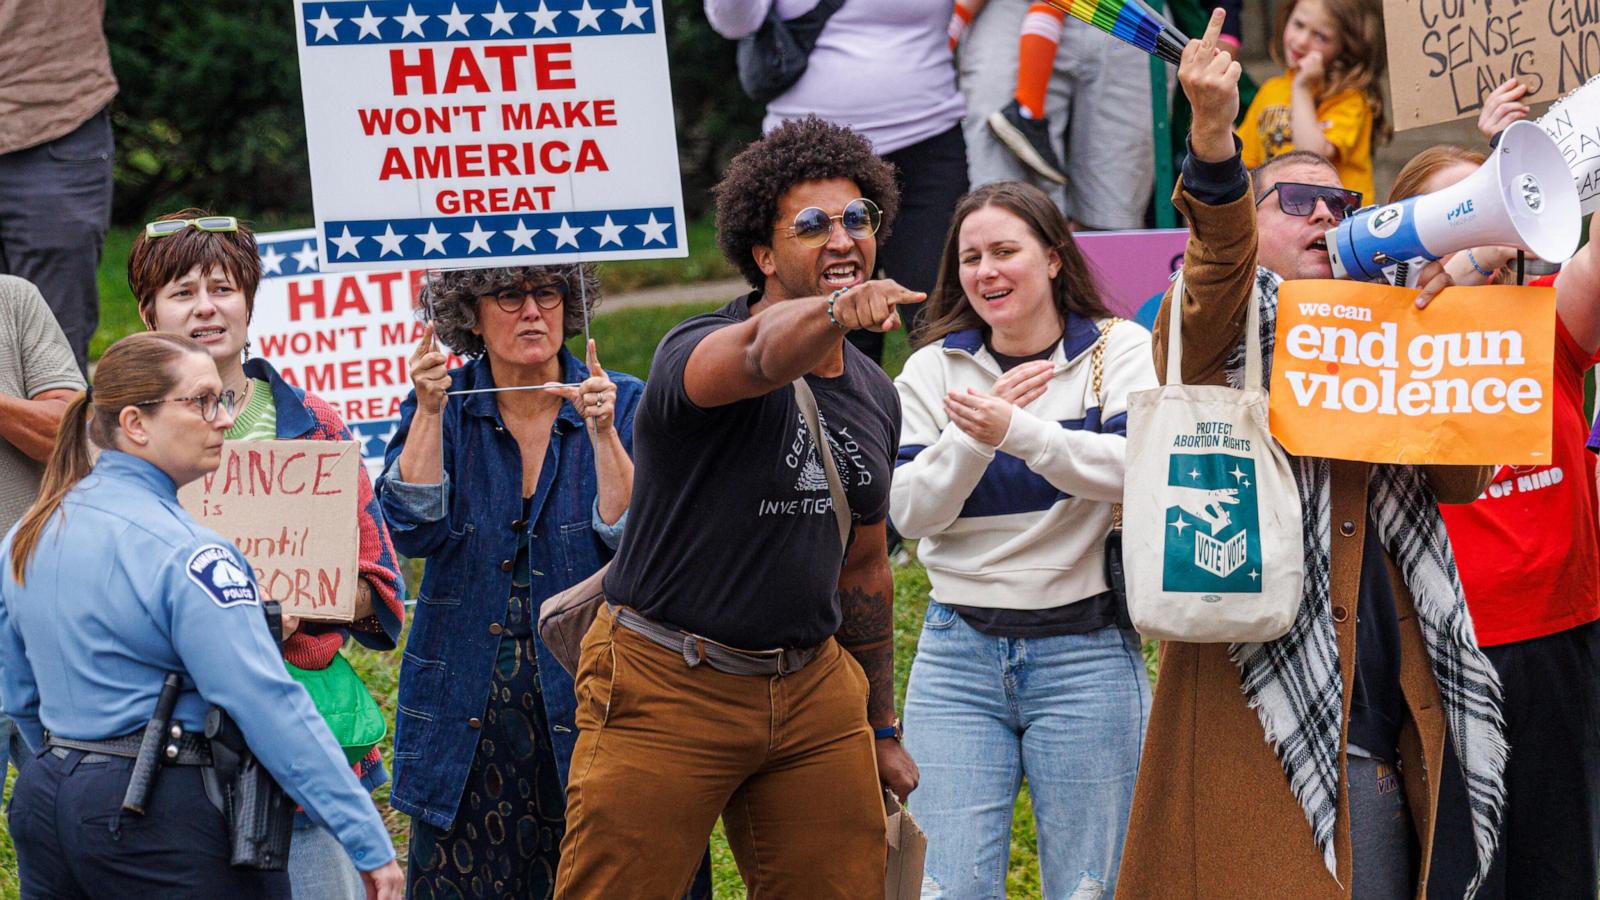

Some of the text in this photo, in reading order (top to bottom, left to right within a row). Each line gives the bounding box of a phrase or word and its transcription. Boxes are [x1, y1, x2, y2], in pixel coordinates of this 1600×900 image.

[1422, 10, 1536, 77] SENSE
[389, 42, 577, 97] HATE
[357, 99, 618, 136] WON'T MAKE
[379, 139, 609, 181] AMERICA
[435, 186, 556, 214] GREAT
[1298, 302, 1372, 322] we can
[260, 326, 367, 358] WON'T
[1286, 322, 1525, 380] end gun
[1285, 362, 1543, 417] violence
[1173, 434, 1251, 452] ABORTION RIGHTS
[1196, 421, 1233, 436] PROTECT
[839, 426, 872, 487] YOUR
[1488, 466, 1564, 499] OF MIND
[203, 499, 223, 517] is
[234, 526, 309, 558] until
[1197, 533, 1246, 573] VOTE VOTE
[222, 586, 255, 602] POLICE
